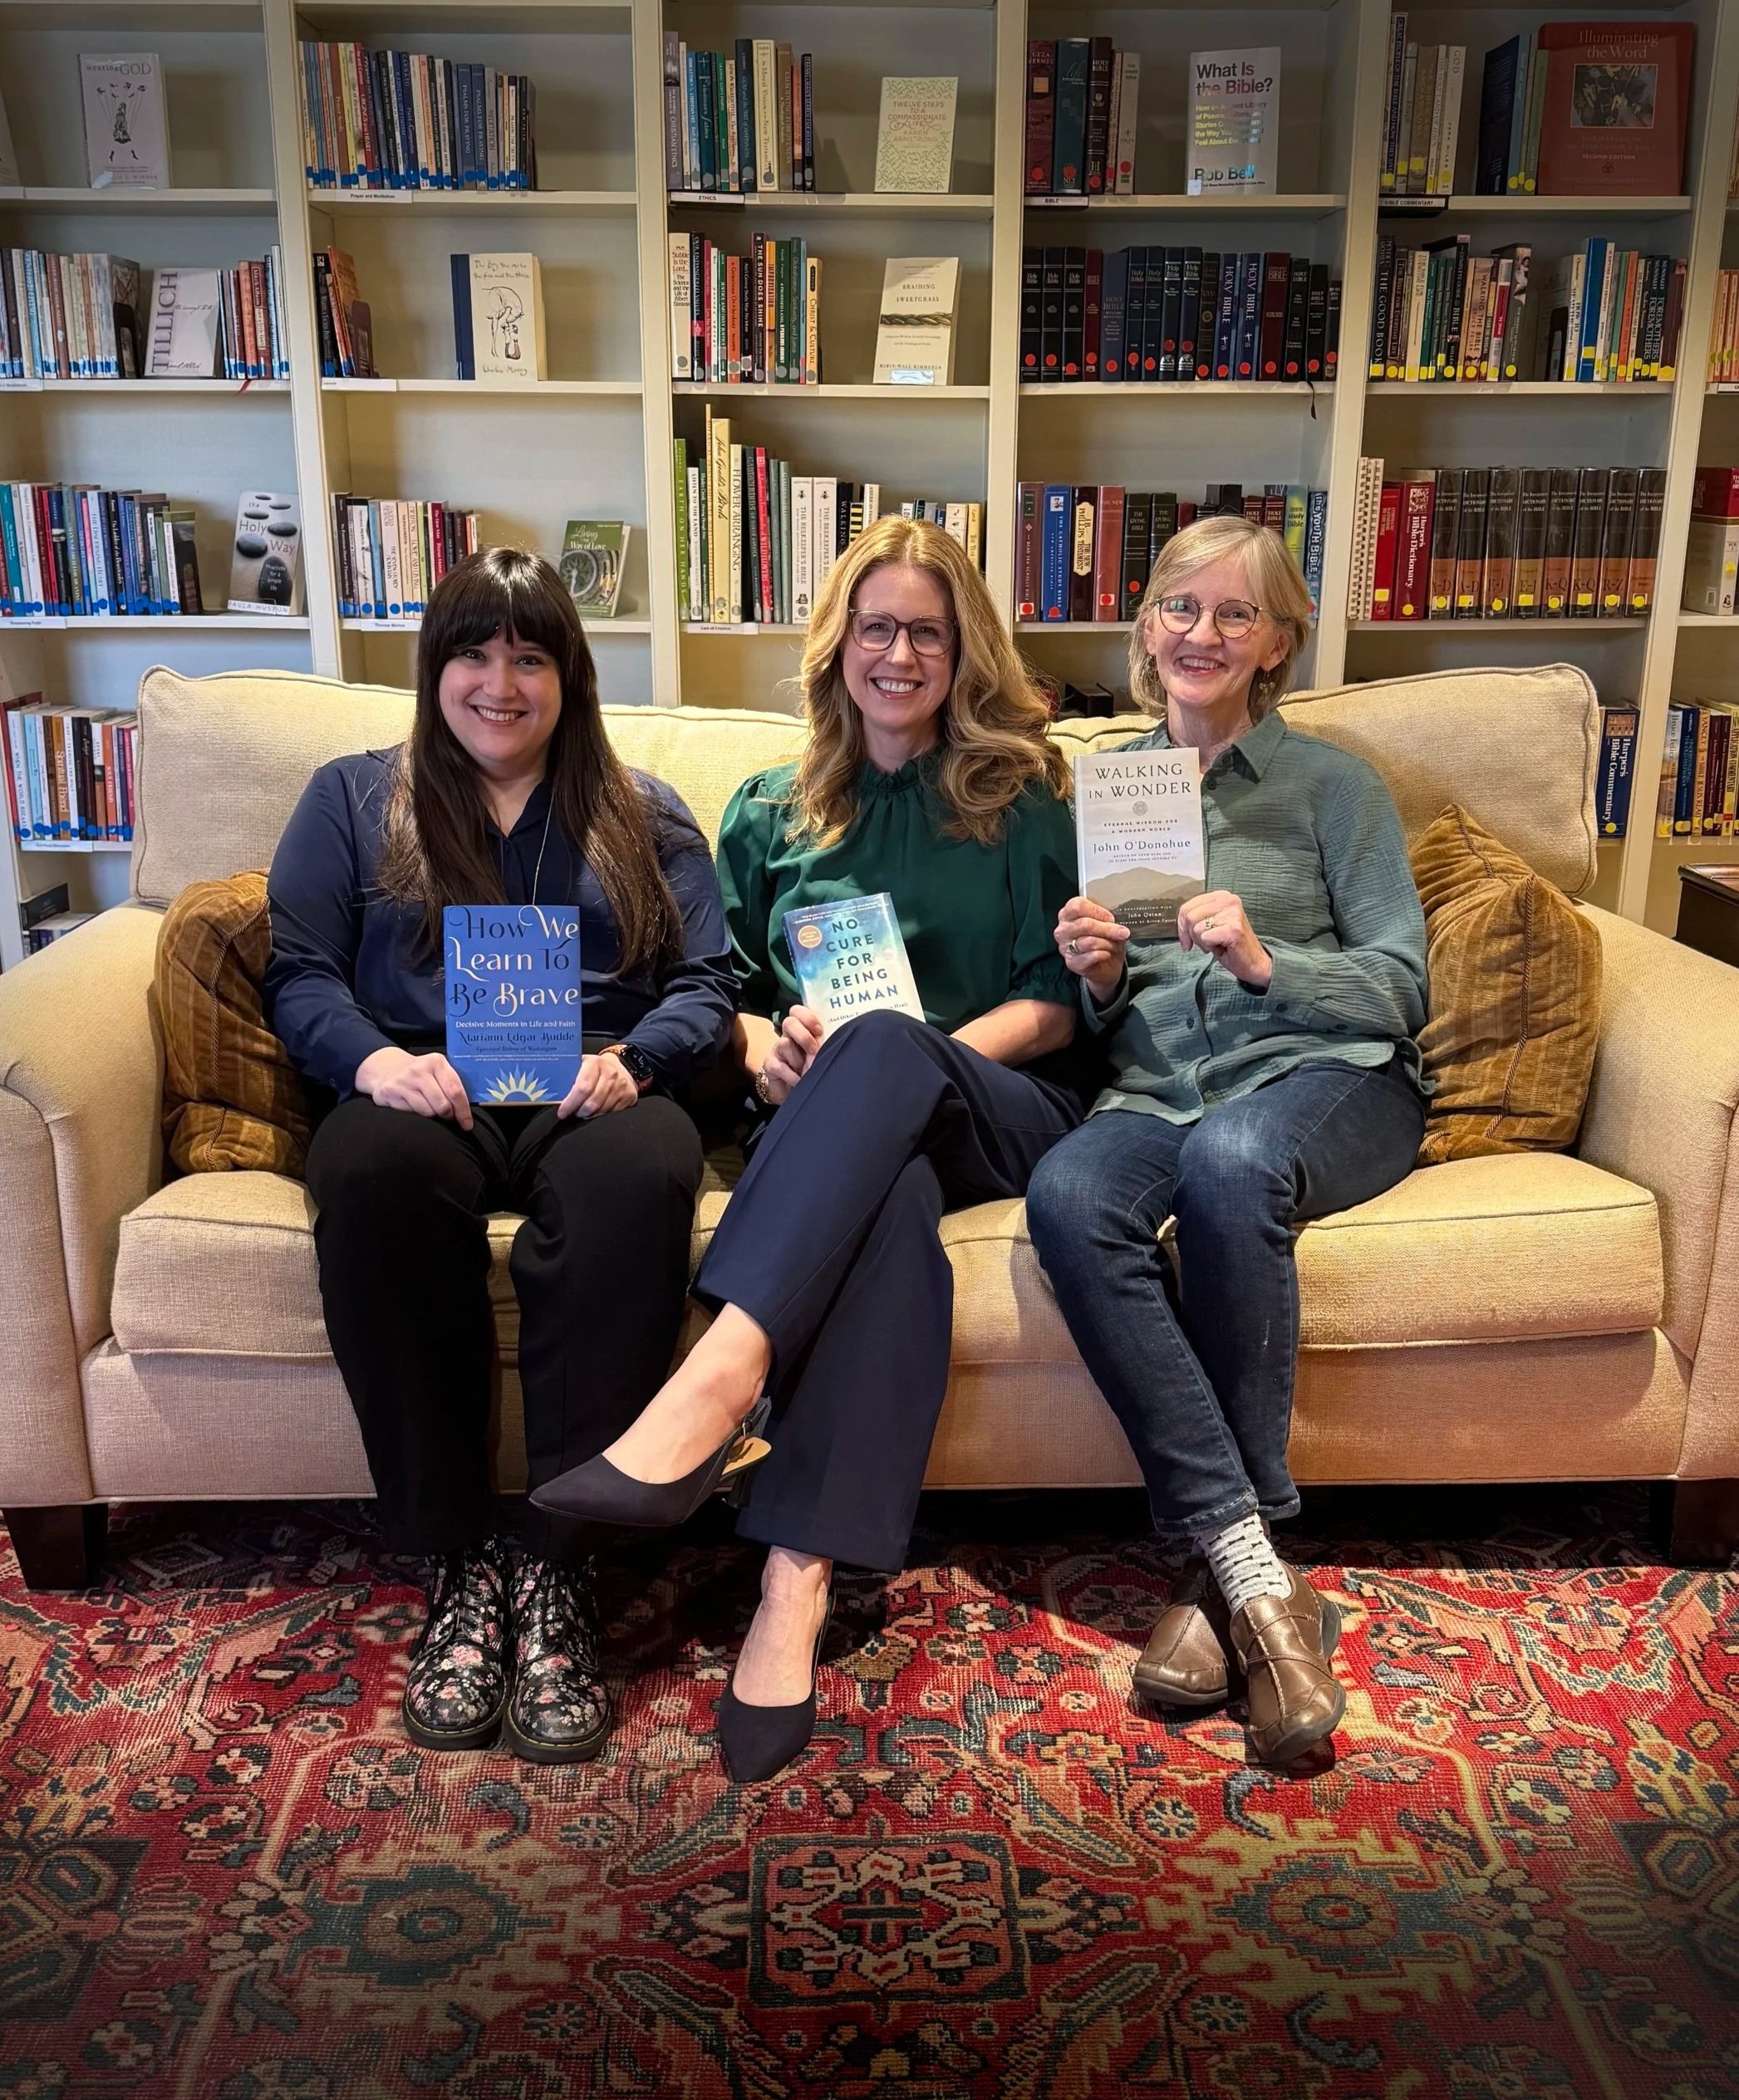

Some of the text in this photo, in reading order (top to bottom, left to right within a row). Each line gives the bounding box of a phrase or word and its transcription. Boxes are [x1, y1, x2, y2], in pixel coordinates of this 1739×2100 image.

[1579, 31, 1660, 47] Illuminating
[1453, 50, 1461, 74] GOD
[1587, 46, 1648, 58] the Word
[120, 63, 152, 76] GOD
[1196, 61, 1255, 79] What Is
[1196, 77, 1273, 96] the Bible?
[1194, 164, 1255, 181] Rob Bell
[1221, 265, 1234, 324] HOLY BIBLE
[1245, 262, 1257, 321] HOLY BIBLE
[1479, 274, 1487, 312] WALKING
[151, 272, 178, 373] TILLICH
[809, 299, 818, 323] CHRIST
[1374, 272, 1388, 364] THE GOOD BOOK
[1451, 307, 1460, 332] BIBLE
[810, 325, 816, 333] &
[1643, 297, 1657, 360] FOREMOTHERS
[1652, 297, 1665, 360] FOREMOTHERS
[715, 436, 725, 458] John
[717, 489, 729, 520] Birds
[239, 520, 268, 536] Holy
[679, 518, 686, 531] ON
[732, 469, 741, 571] FLOWER ARRANGING
[1312, 513, 1323, 542] YOUTH
[1417, 516, 1427, 547] Harper's
[571, 525, 598, 542] Living
[92, 527, 101, 565] DISCERNING
[270, 540, 296, 555] Way
[571, 542, 583, 550] Way
[1076, 540, 1084, 571] TESTAMENT
[1405, 516, 1419, 589] Bible Dictionary
[1309, 545, 1319, 573] BIBLE
[228, 601, 287, 613] PAULA HUSTON
[1620, 738, 1631, 777] Harper's
[56, 750, 69, 812] Spiritual Friend
[1095, 763, 1183, 779] WALKING
[1603, 738, 1619, 822] Bible Commentary
[1088, 782, 1191, 799] IN WONDER
[1093, 840, 1191, 854] John O'Donohue
[448, 905, 579, 940] How We
[832, 919, 858, 934] NO
[826, 934, 874, 953] CURE
[448, 936, 570, 982] Learn To
[837, 953, 873, 969] FOR
[831, 969, 887, 990] BEING
[449, 983, 579, 1017] Be Brave
[830, 984, 899, 1008] HUMAN
[458, 1031, 575, 1045] Mariann Edgar Budde
